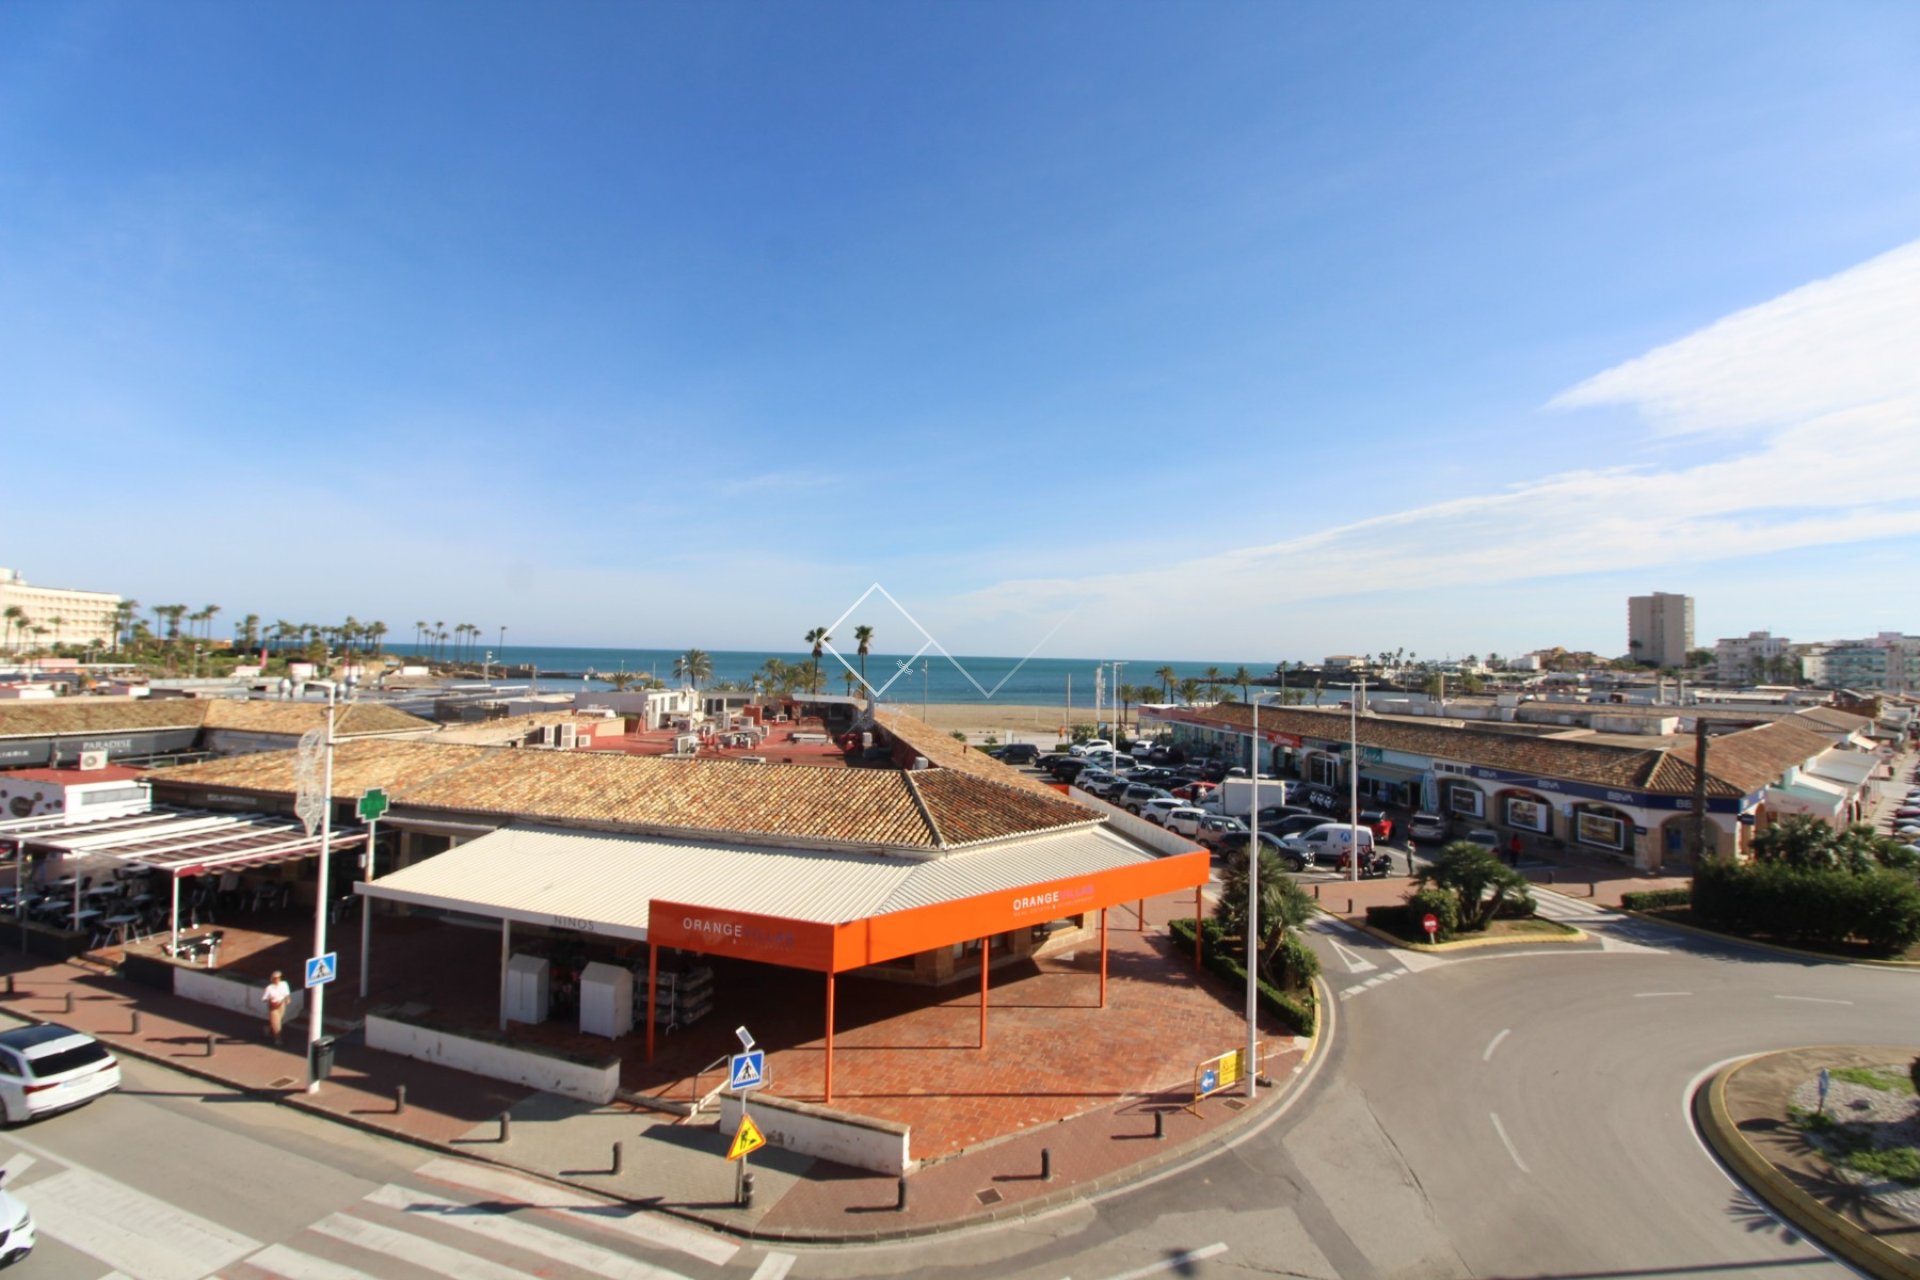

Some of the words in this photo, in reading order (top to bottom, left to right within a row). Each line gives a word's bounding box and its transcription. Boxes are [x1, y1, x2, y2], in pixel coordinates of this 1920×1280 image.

[83, 739, 132, 750] PARADISE
[1537, 779, 1560, 790] BBVA
[1607, 791, 1634, 802] BBVA
[1013, 891, 1059, 910] ORANGE
[683, 917, 742, 937] ORANGE
